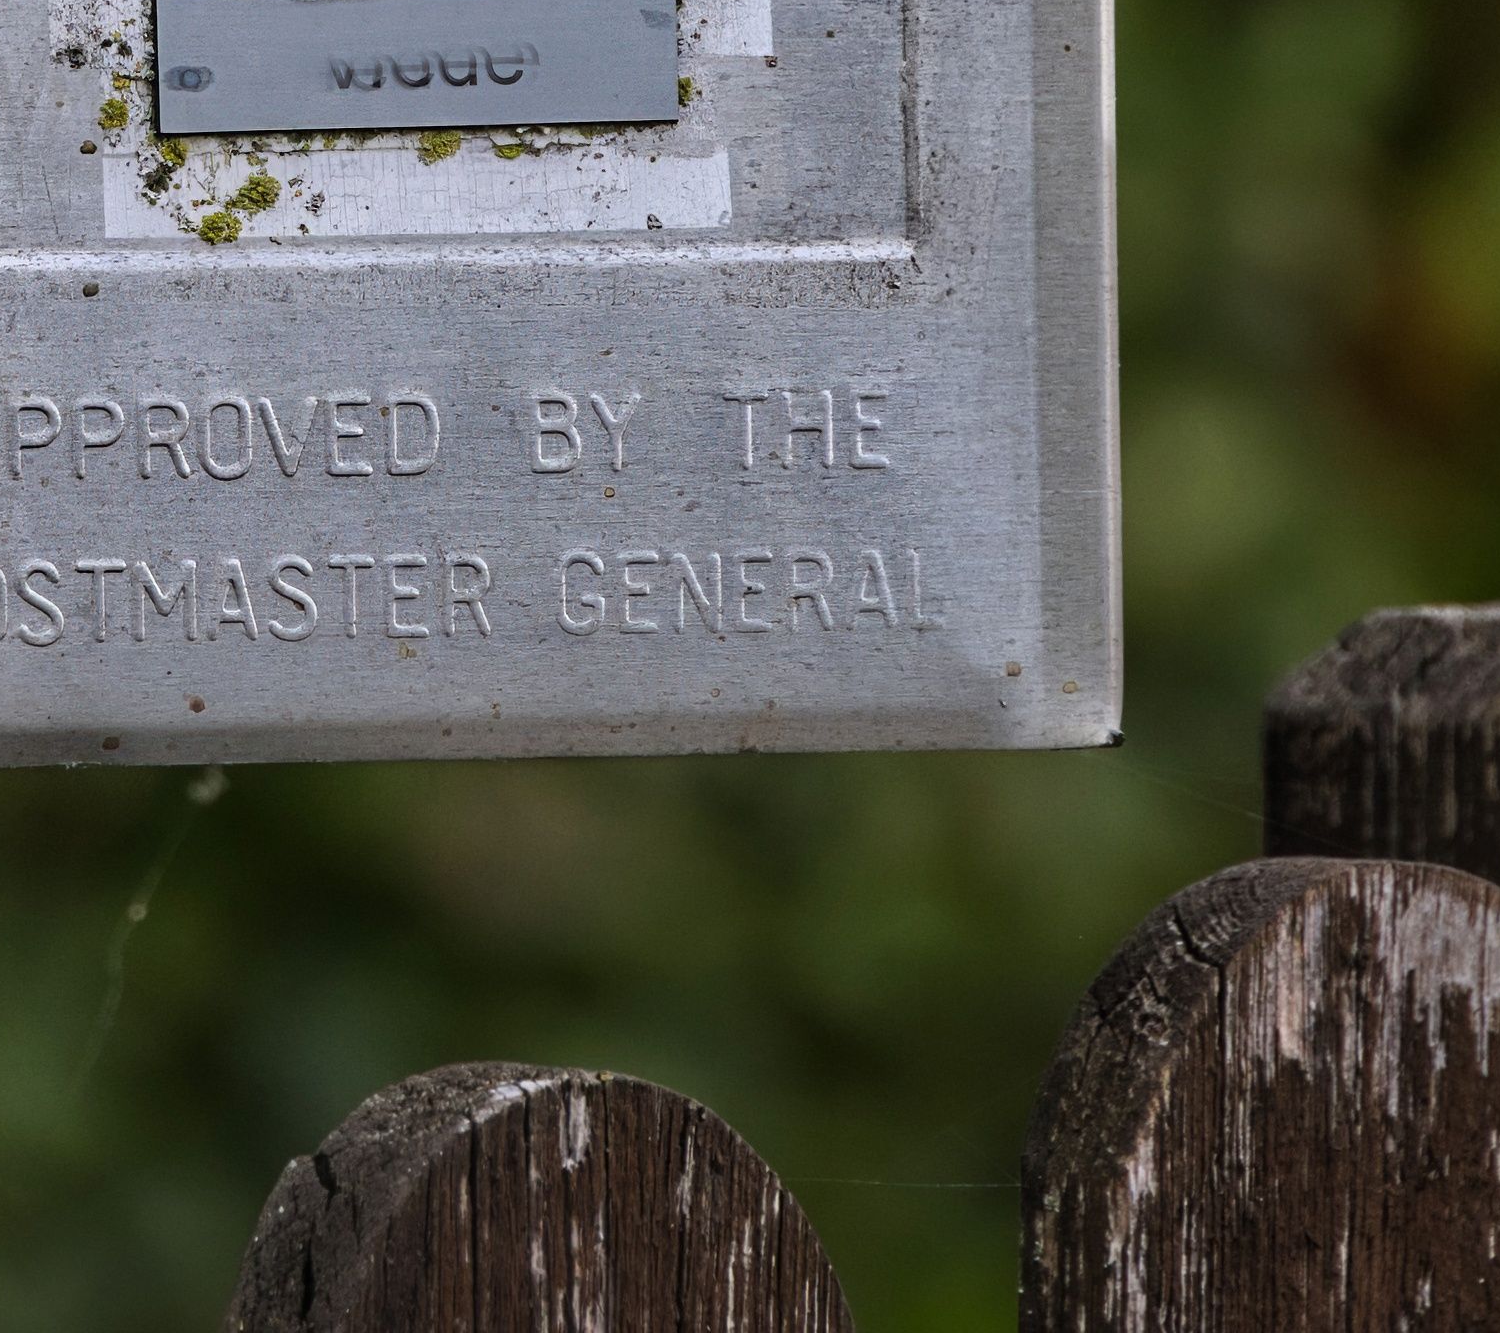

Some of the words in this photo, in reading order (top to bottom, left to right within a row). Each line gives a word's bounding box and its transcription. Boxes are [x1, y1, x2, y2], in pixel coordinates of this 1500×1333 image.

[531, 389, 642, 473] BY
[722, 388, 891, 471] THE
[556, 547, 944, 636] GENERAL
